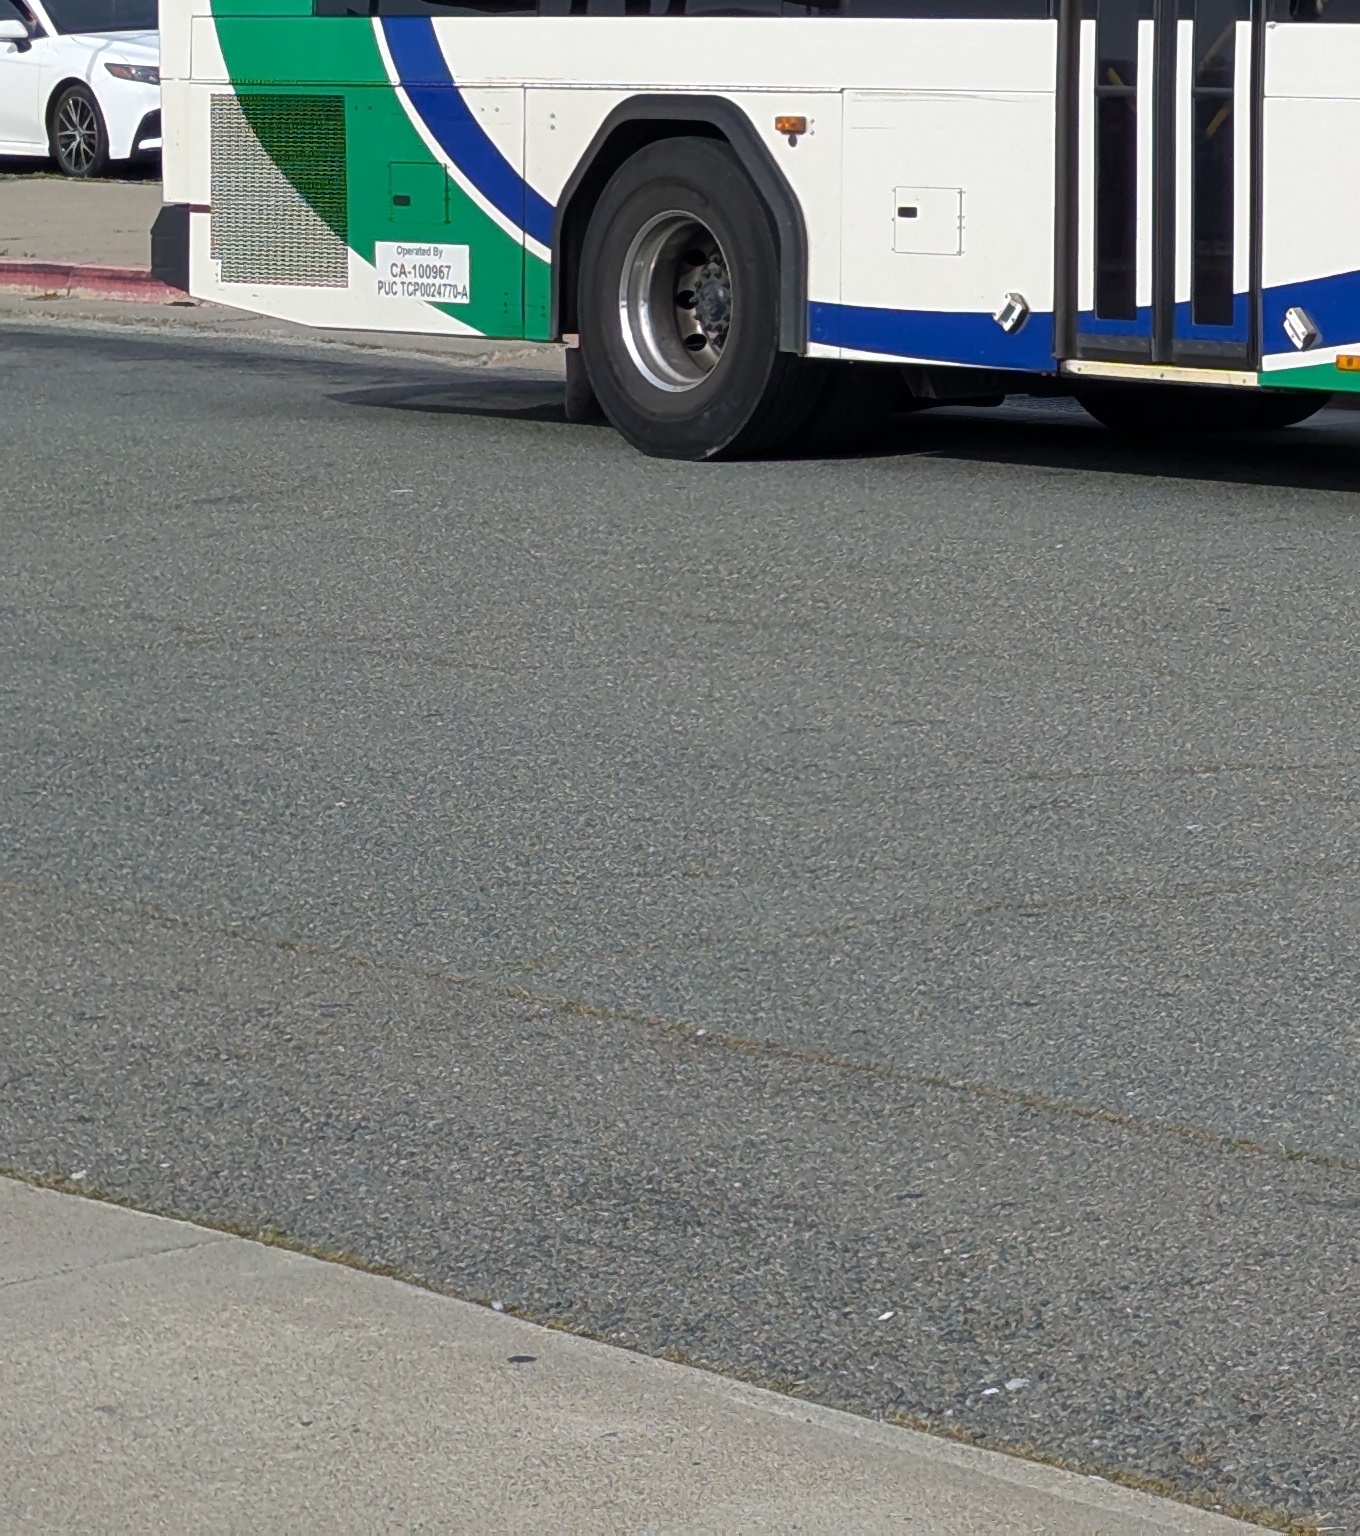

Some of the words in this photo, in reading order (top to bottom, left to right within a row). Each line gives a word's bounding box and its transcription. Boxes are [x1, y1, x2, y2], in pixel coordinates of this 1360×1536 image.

[396, 245, 431, 257] Operated
[433, 246, 444, 259] By
[390, 263, 452, 280] CA-100967
[377, 280, 398, 296] PUC
[400, 281, 468, 299] TCP0024770-A
